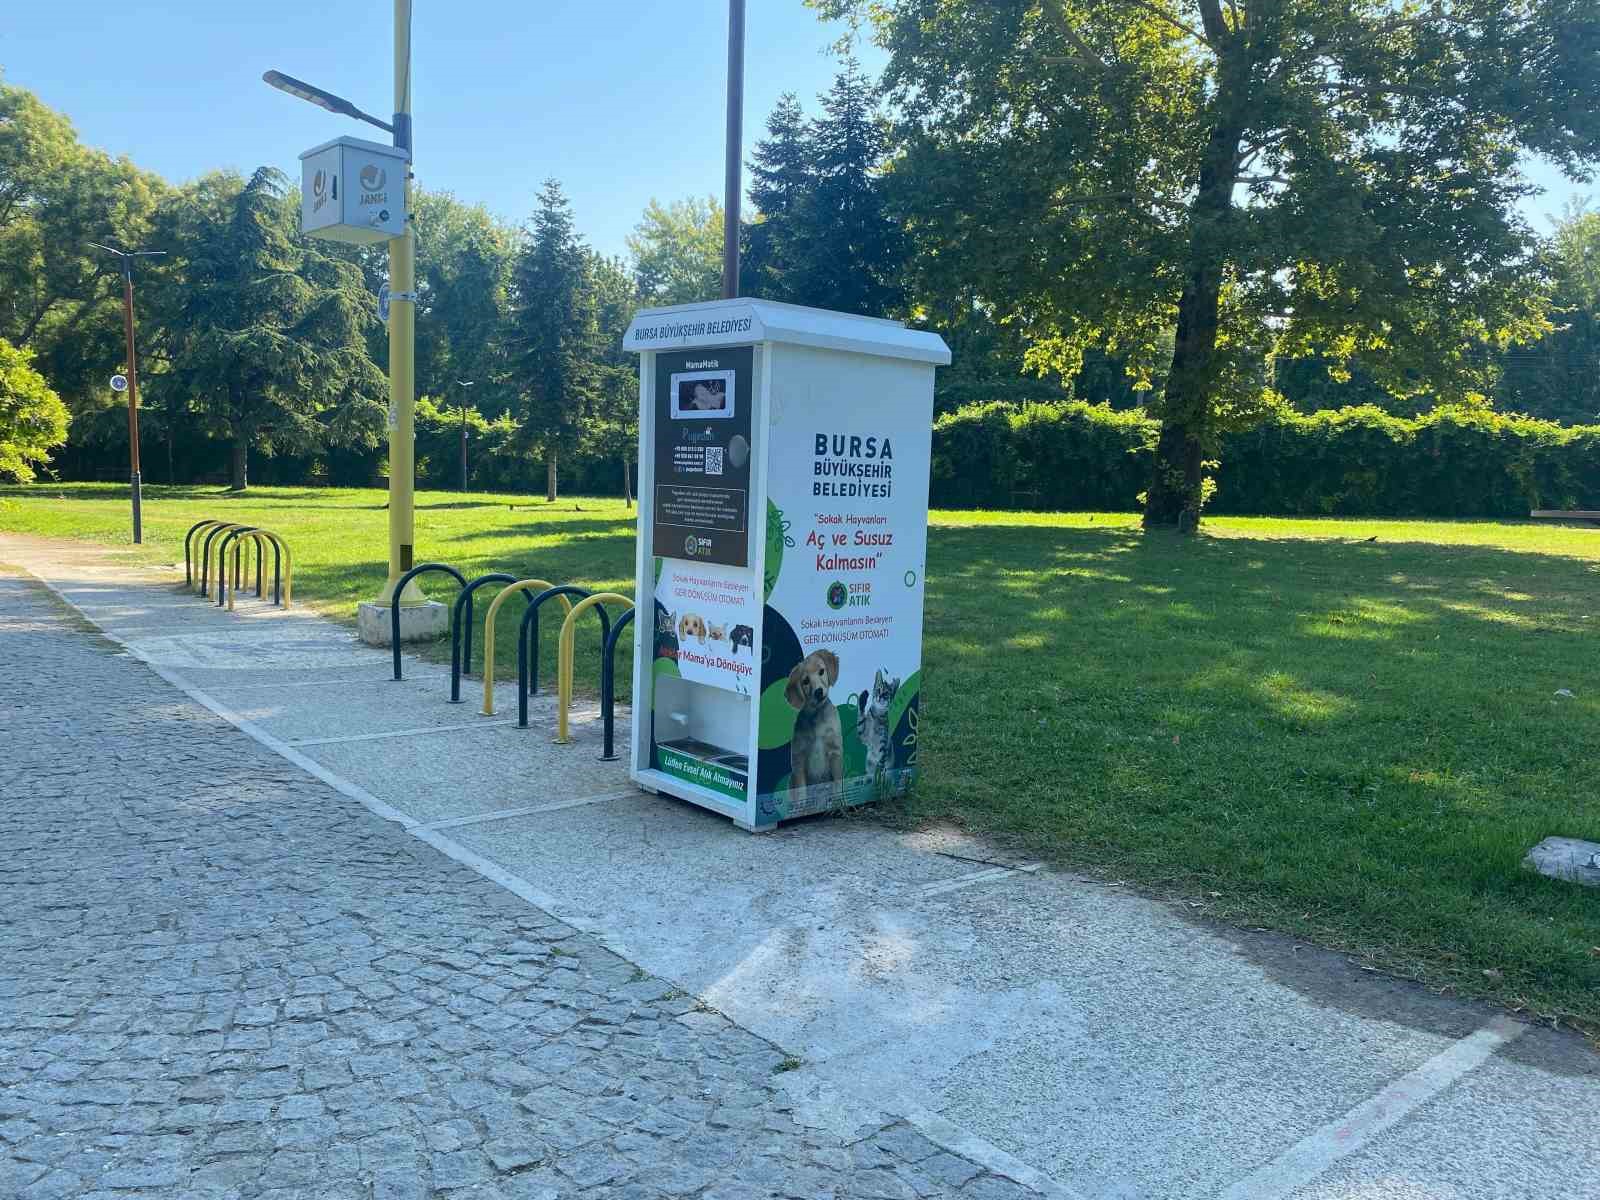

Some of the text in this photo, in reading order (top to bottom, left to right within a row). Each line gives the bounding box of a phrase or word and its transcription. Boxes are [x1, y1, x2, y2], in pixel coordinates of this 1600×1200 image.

[635, 327, 658, 340] BURSA
[815, 433, 892, 460] BURSA
[813, 479, 891, 498] BELEDİYESİ
[846, 513, 887, 526] Hayvanları
[806, 529, 893, 550] Aç ve Susuz
[848, 583, 871, 593] SIFIR
[848, 594, 871, 607] ATIK
[683, 650, 714, 668] Mama'ya
